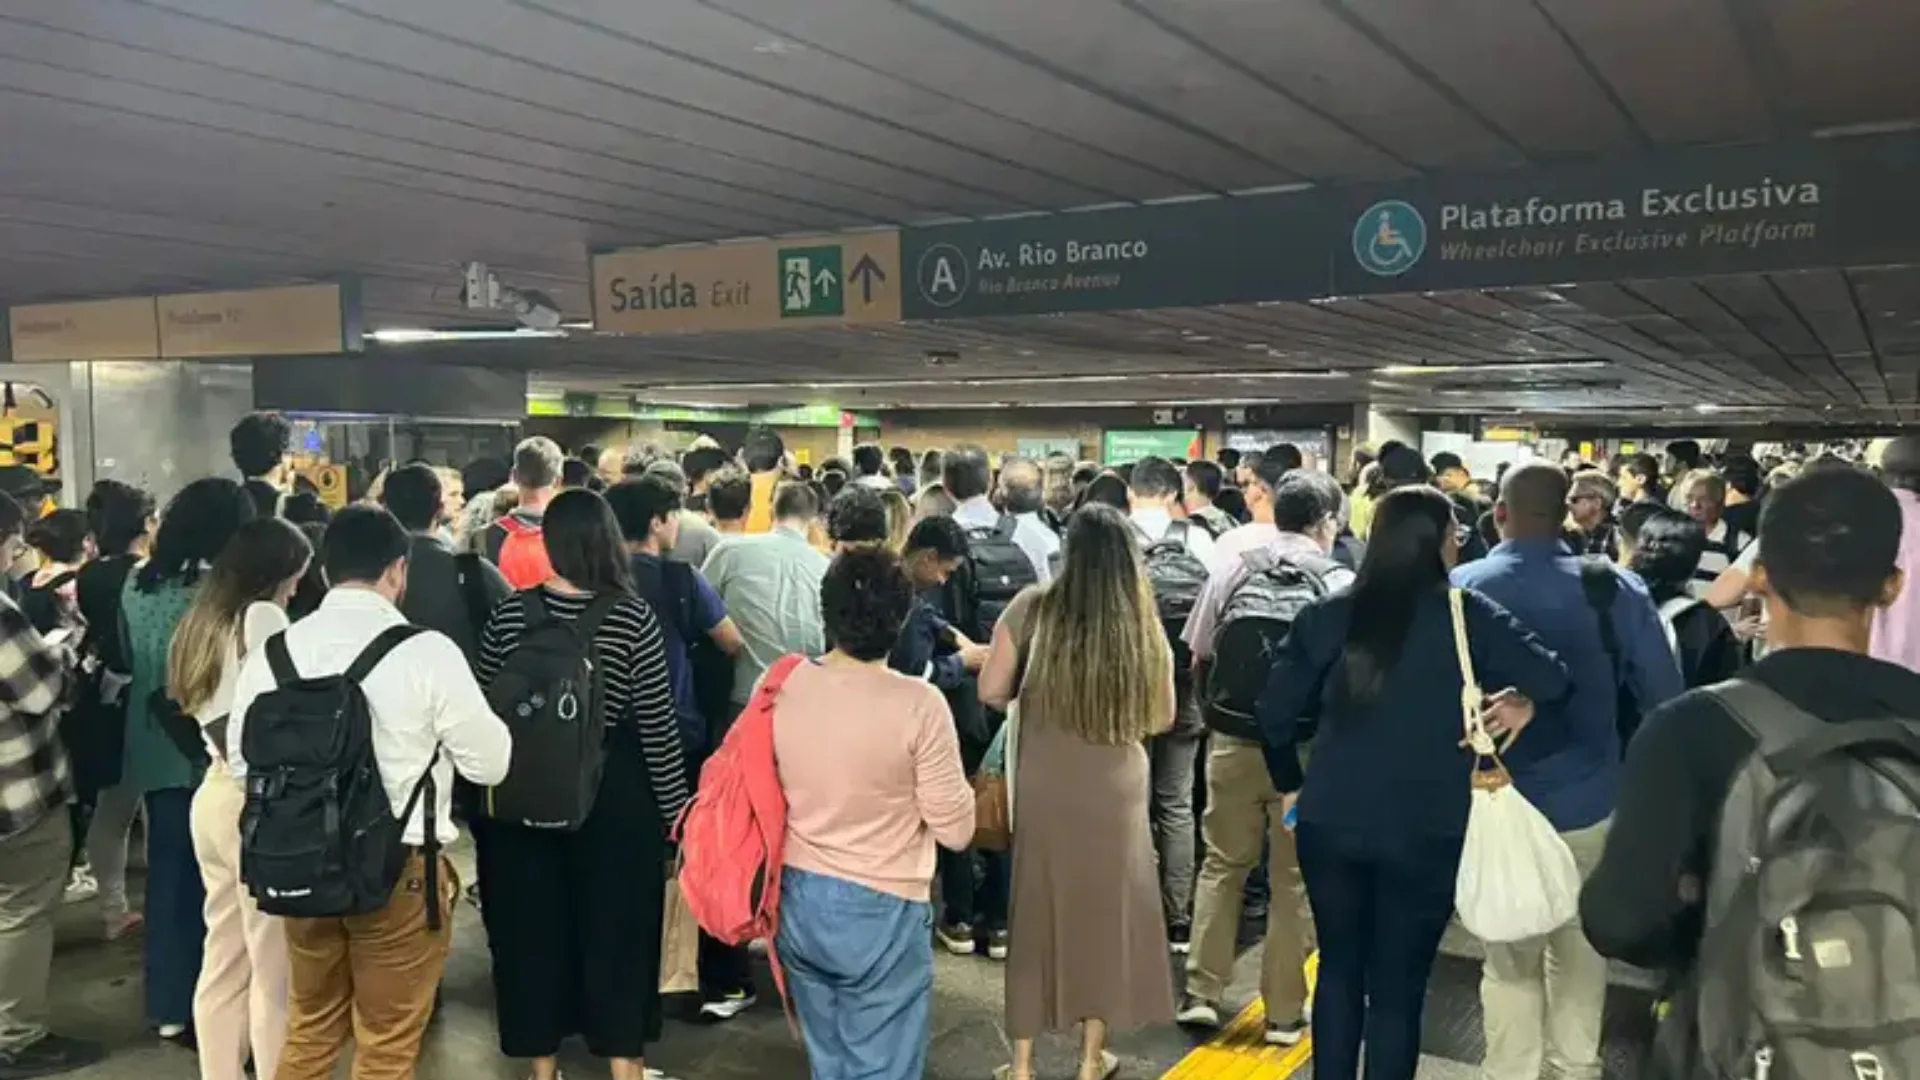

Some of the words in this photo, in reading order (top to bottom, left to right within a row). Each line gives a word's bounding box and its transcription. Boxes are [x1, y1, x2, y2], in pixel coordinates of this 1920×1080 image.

[1440, 197, 1626, 230] Plataforma
[1642, 177, 1820, 216] Exclusiva
[978, 248, 1011, 270] Av.
[1019, 242, 1058, 267] Rio
[1066, 239, 1148, 263] Branco
[1440, 236, 1565, 261] Wheelchair
[1575, 227, 1688, 255] Exclusive
[1700, 217, 1816, 249] Platform
[610, 271, 699, 314] Saída
[711, 279, 750, 308] Exit
[931, 256, 957, 294] A
